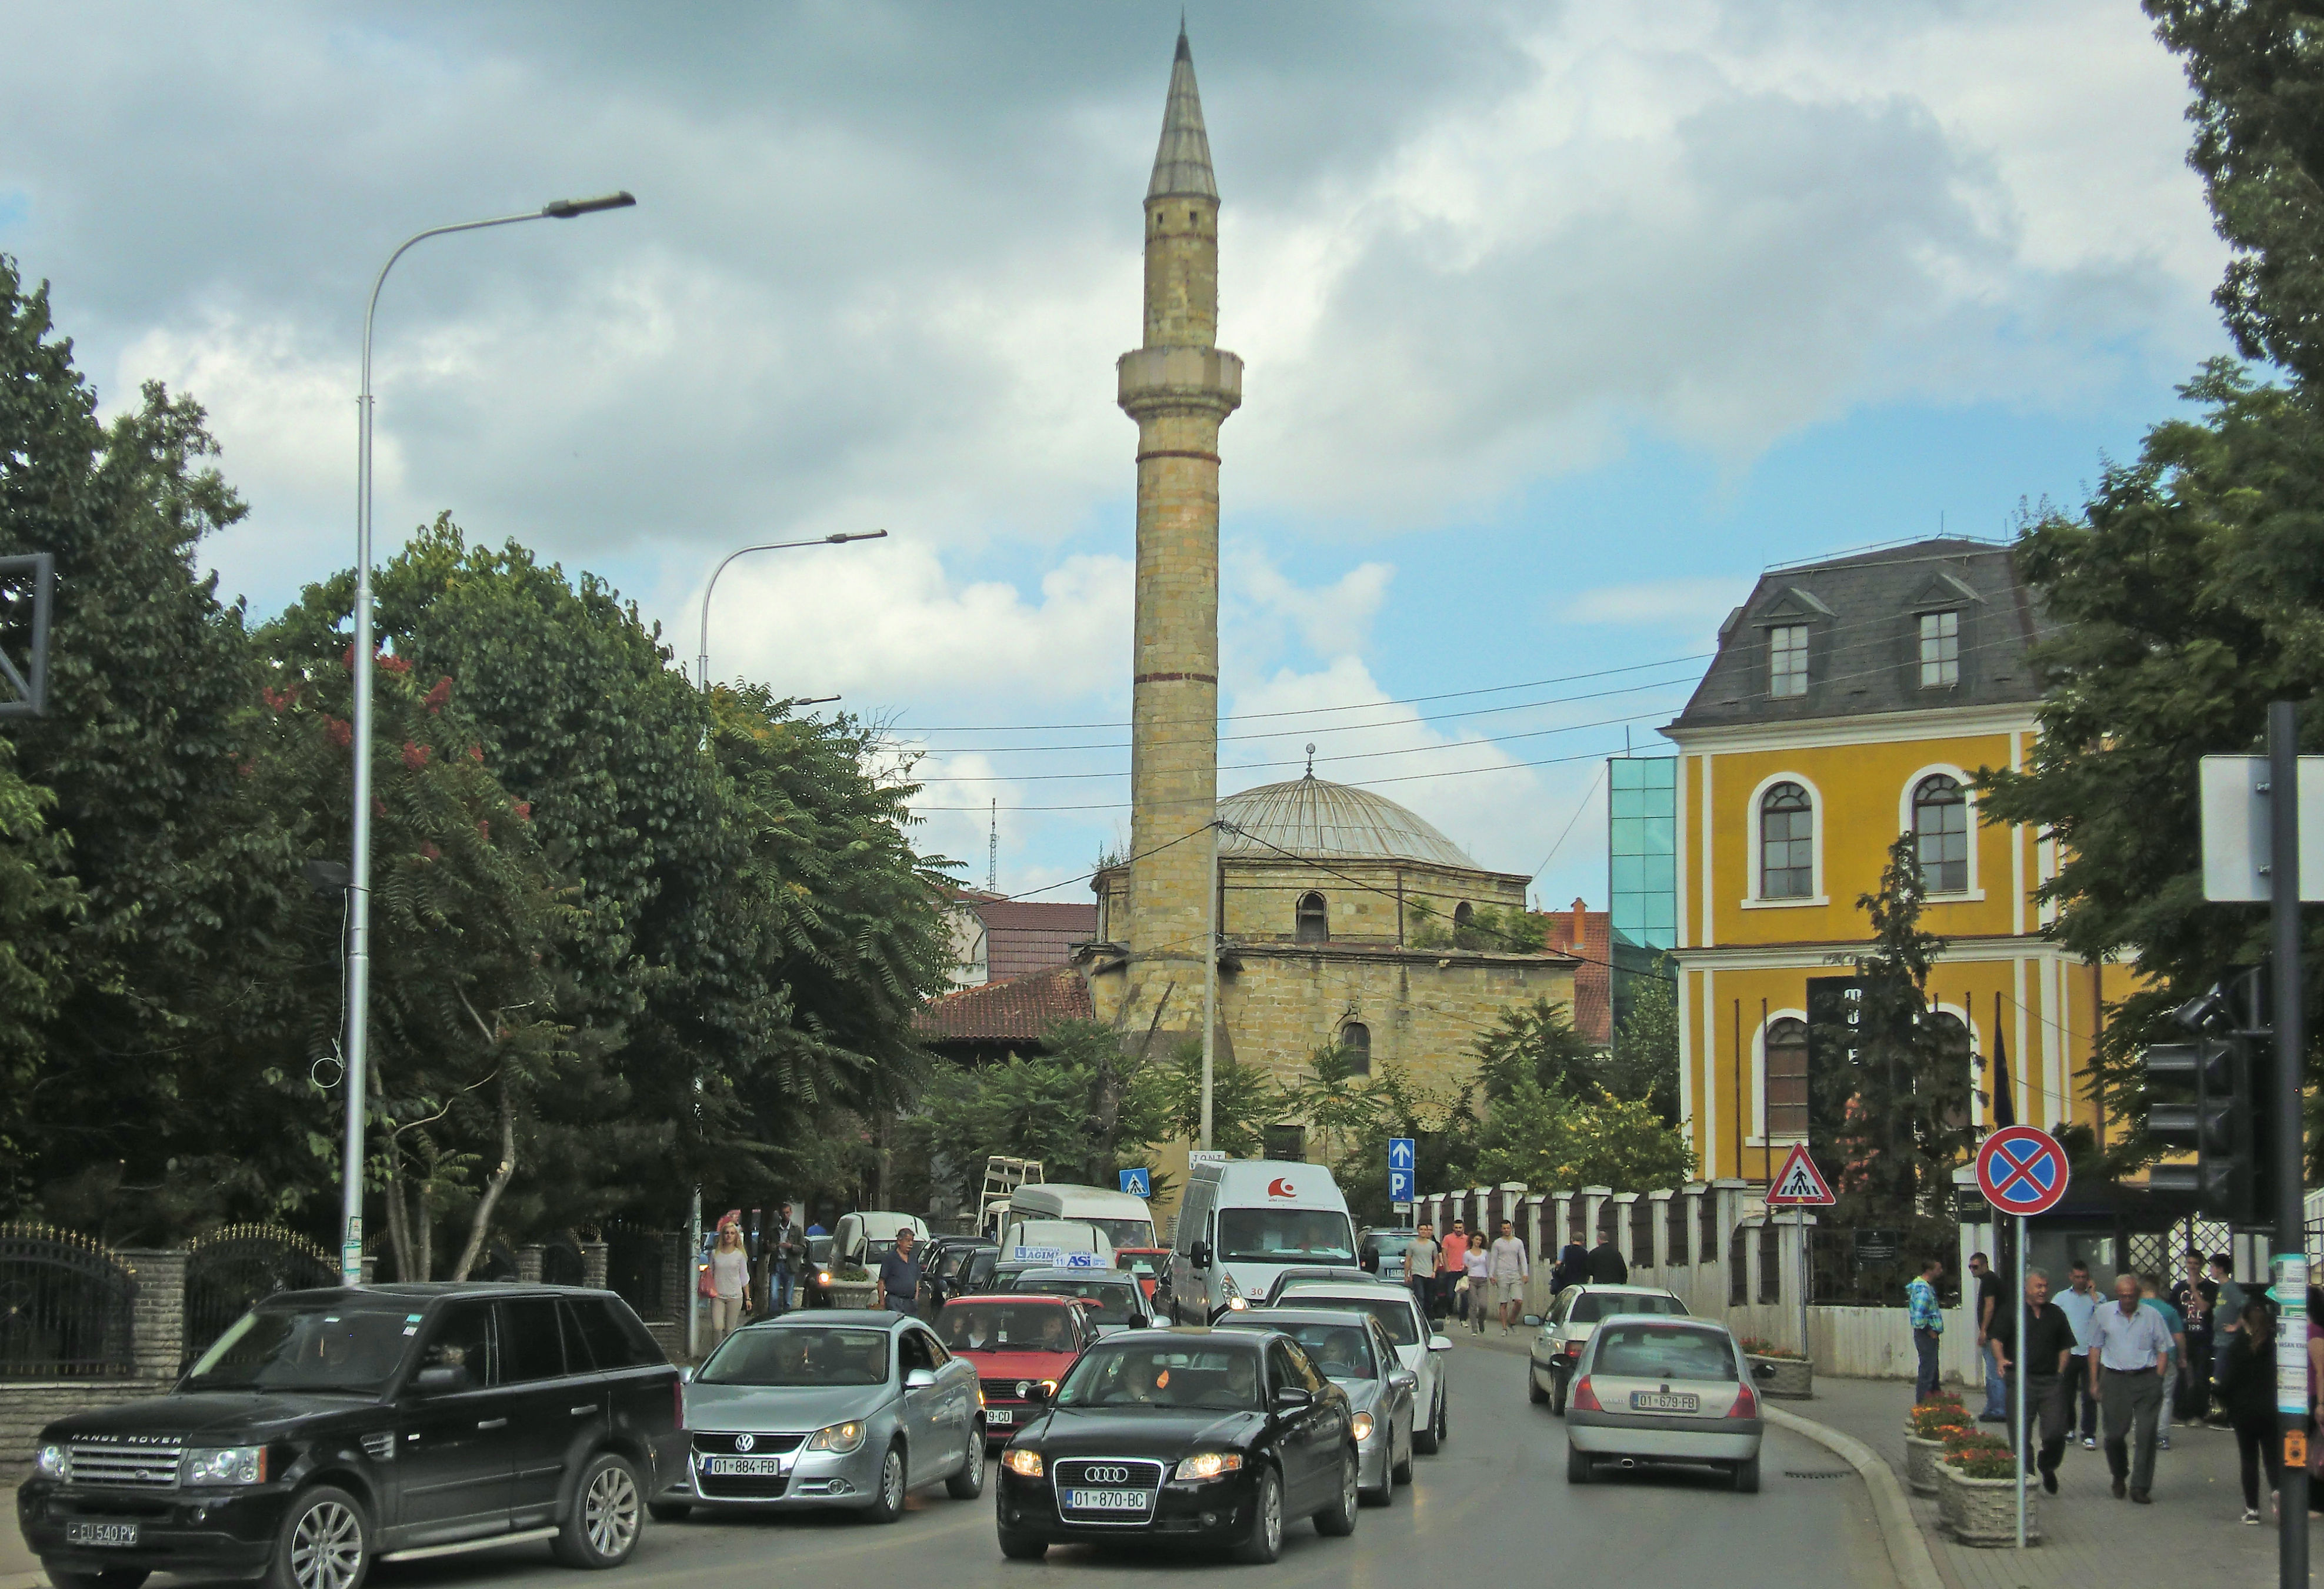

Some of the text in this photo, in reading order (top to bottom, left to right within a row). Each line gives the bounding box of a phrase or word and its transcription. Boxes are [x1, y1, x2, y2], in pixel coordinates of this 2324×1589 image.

[1391, 1173, 1405, 1196] P
[1018, 1248, 1023, 1257] L
[1055, 1258, 1063, 1266] 11
[1066, 1256, 1091, 1267] ASi
[1640, 1395, 1652, 1407] 01
[72, 1434, 182, 1444] RANGE ROVER
[714, 1460, 775, 1474] 01 884-FB
[1075, 1491, 1143, 1507] 01 870-BC
[96, 1525, 118, 1541] 540
